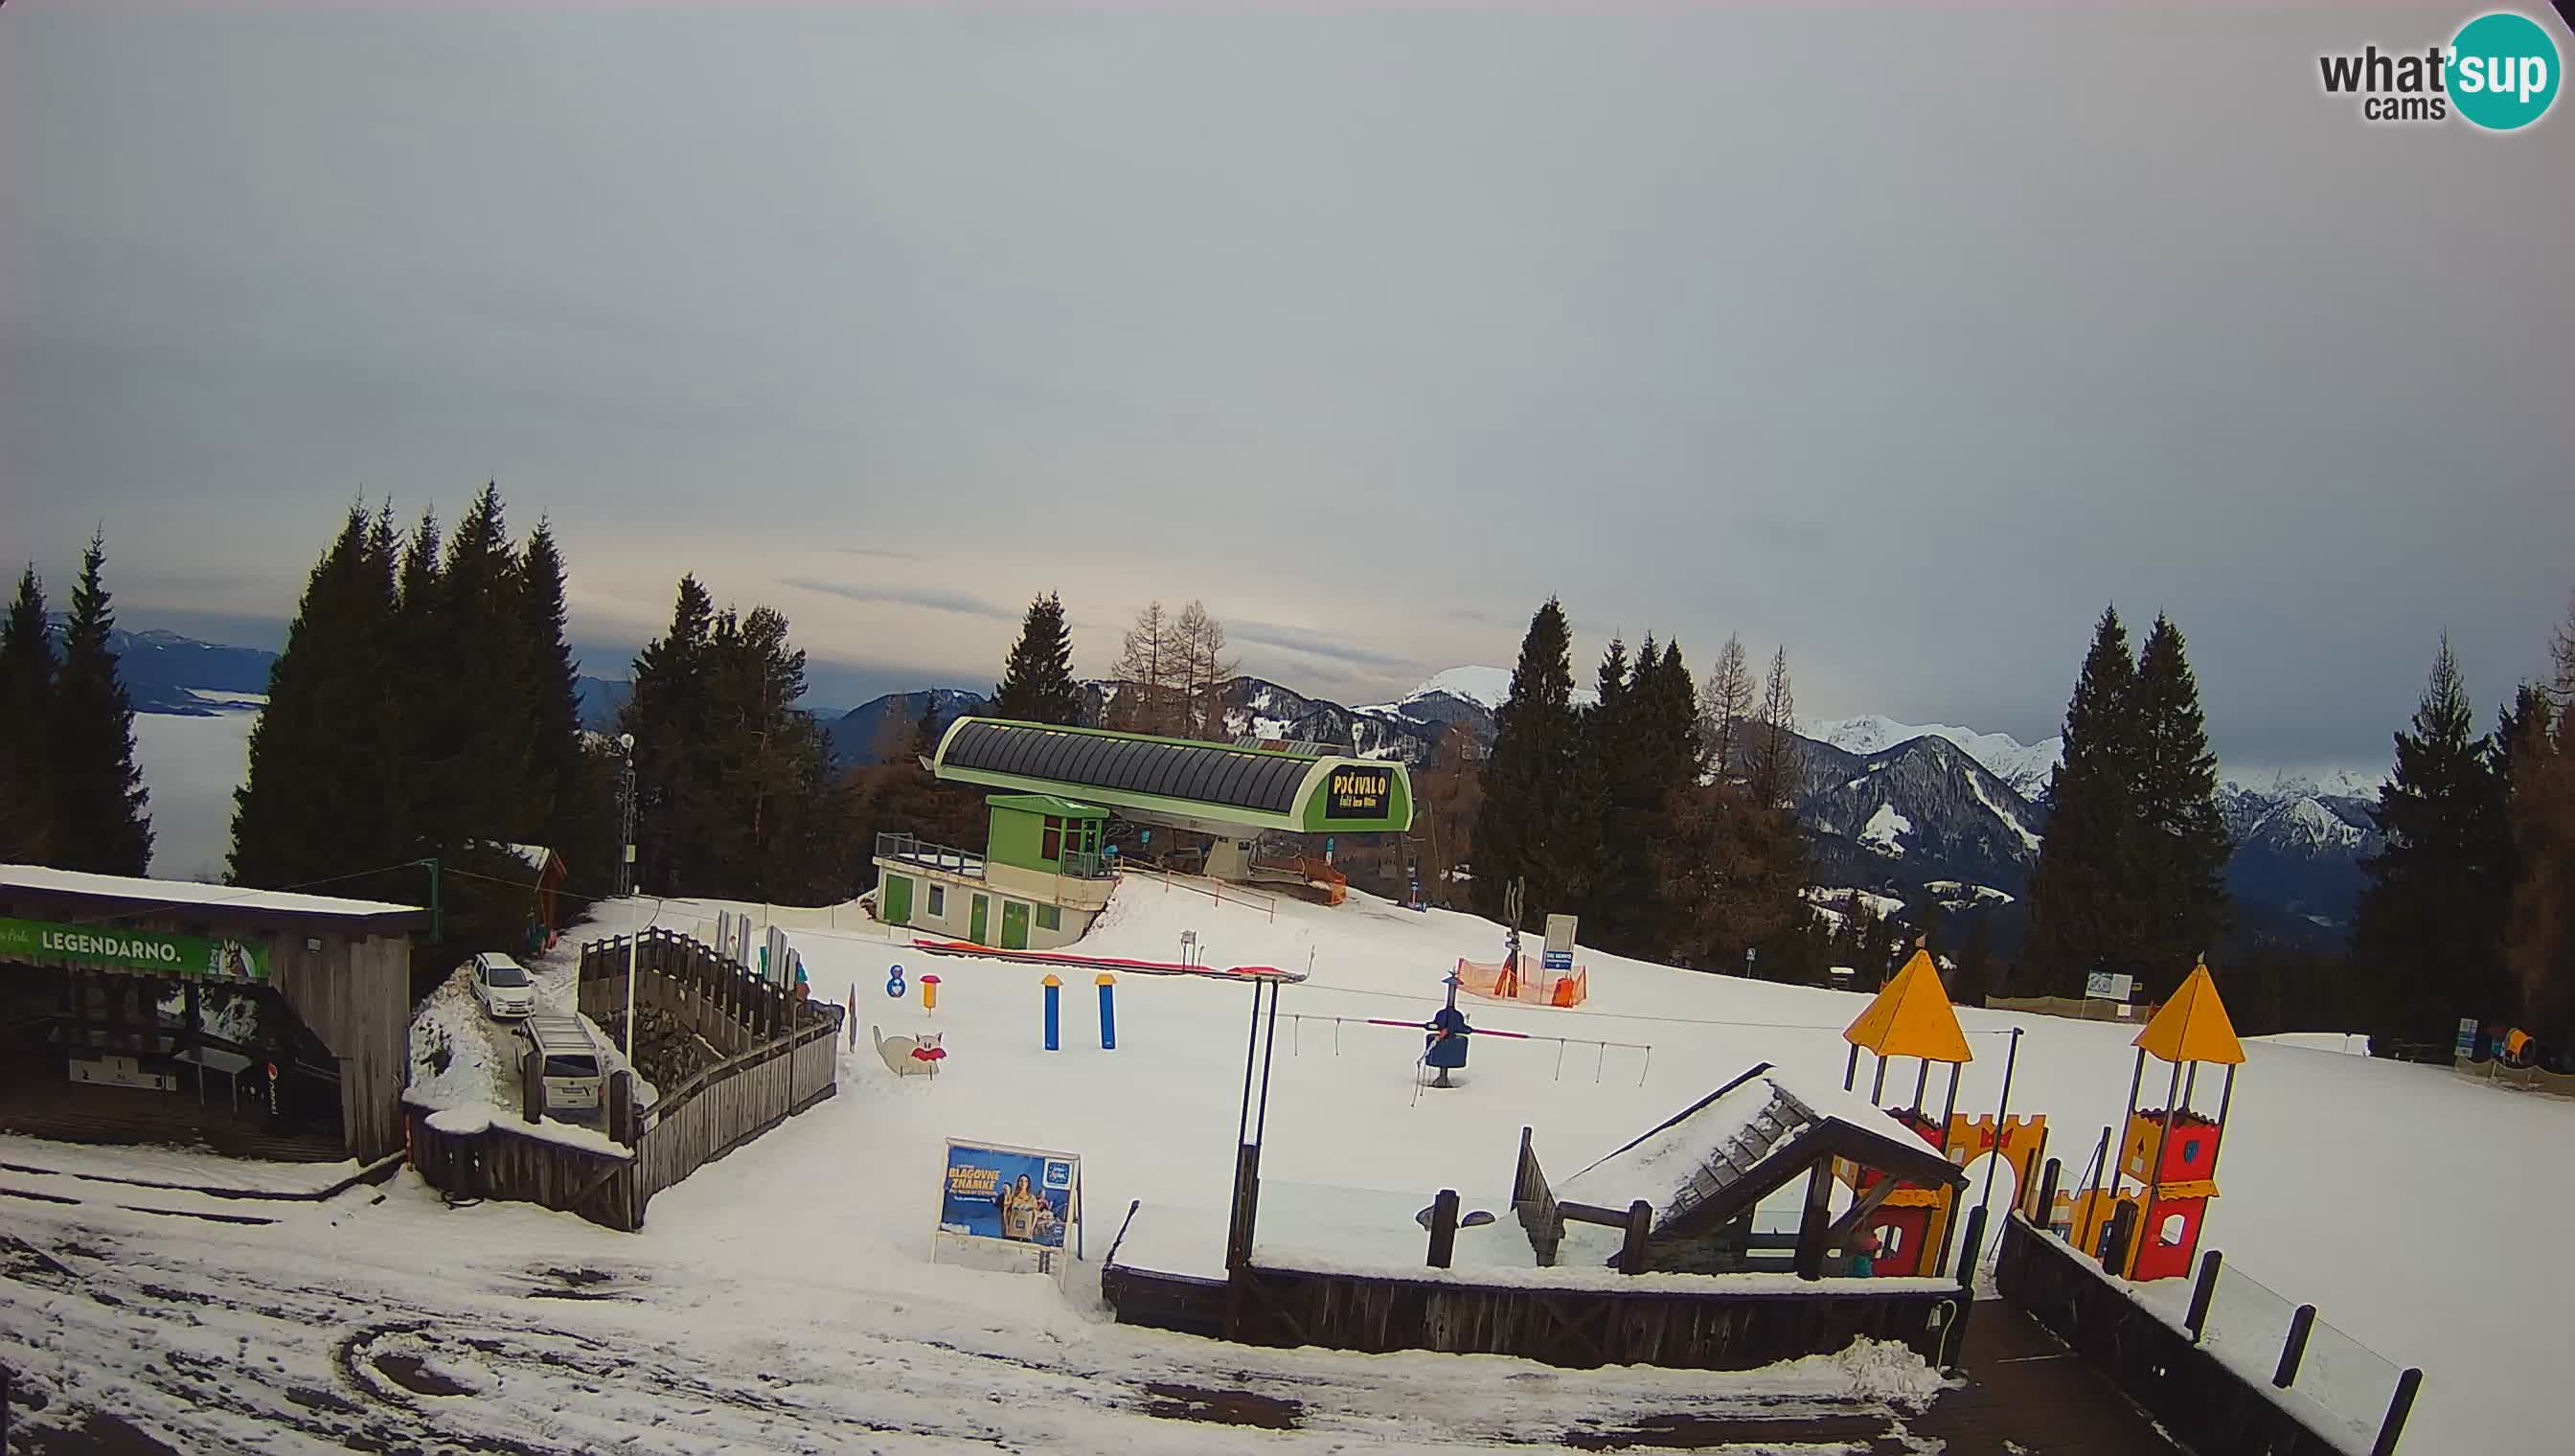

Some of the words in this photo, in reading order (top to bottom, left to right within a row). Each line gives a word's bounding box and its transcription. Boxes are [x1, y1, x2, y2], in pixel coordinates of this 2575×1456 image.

[42, 930, 182, 963] LEGENDARNO.
[949, 1168, 1001, 1180] BLAGOVNE
[951, 1178, 996, 1191] ZNAMKE
